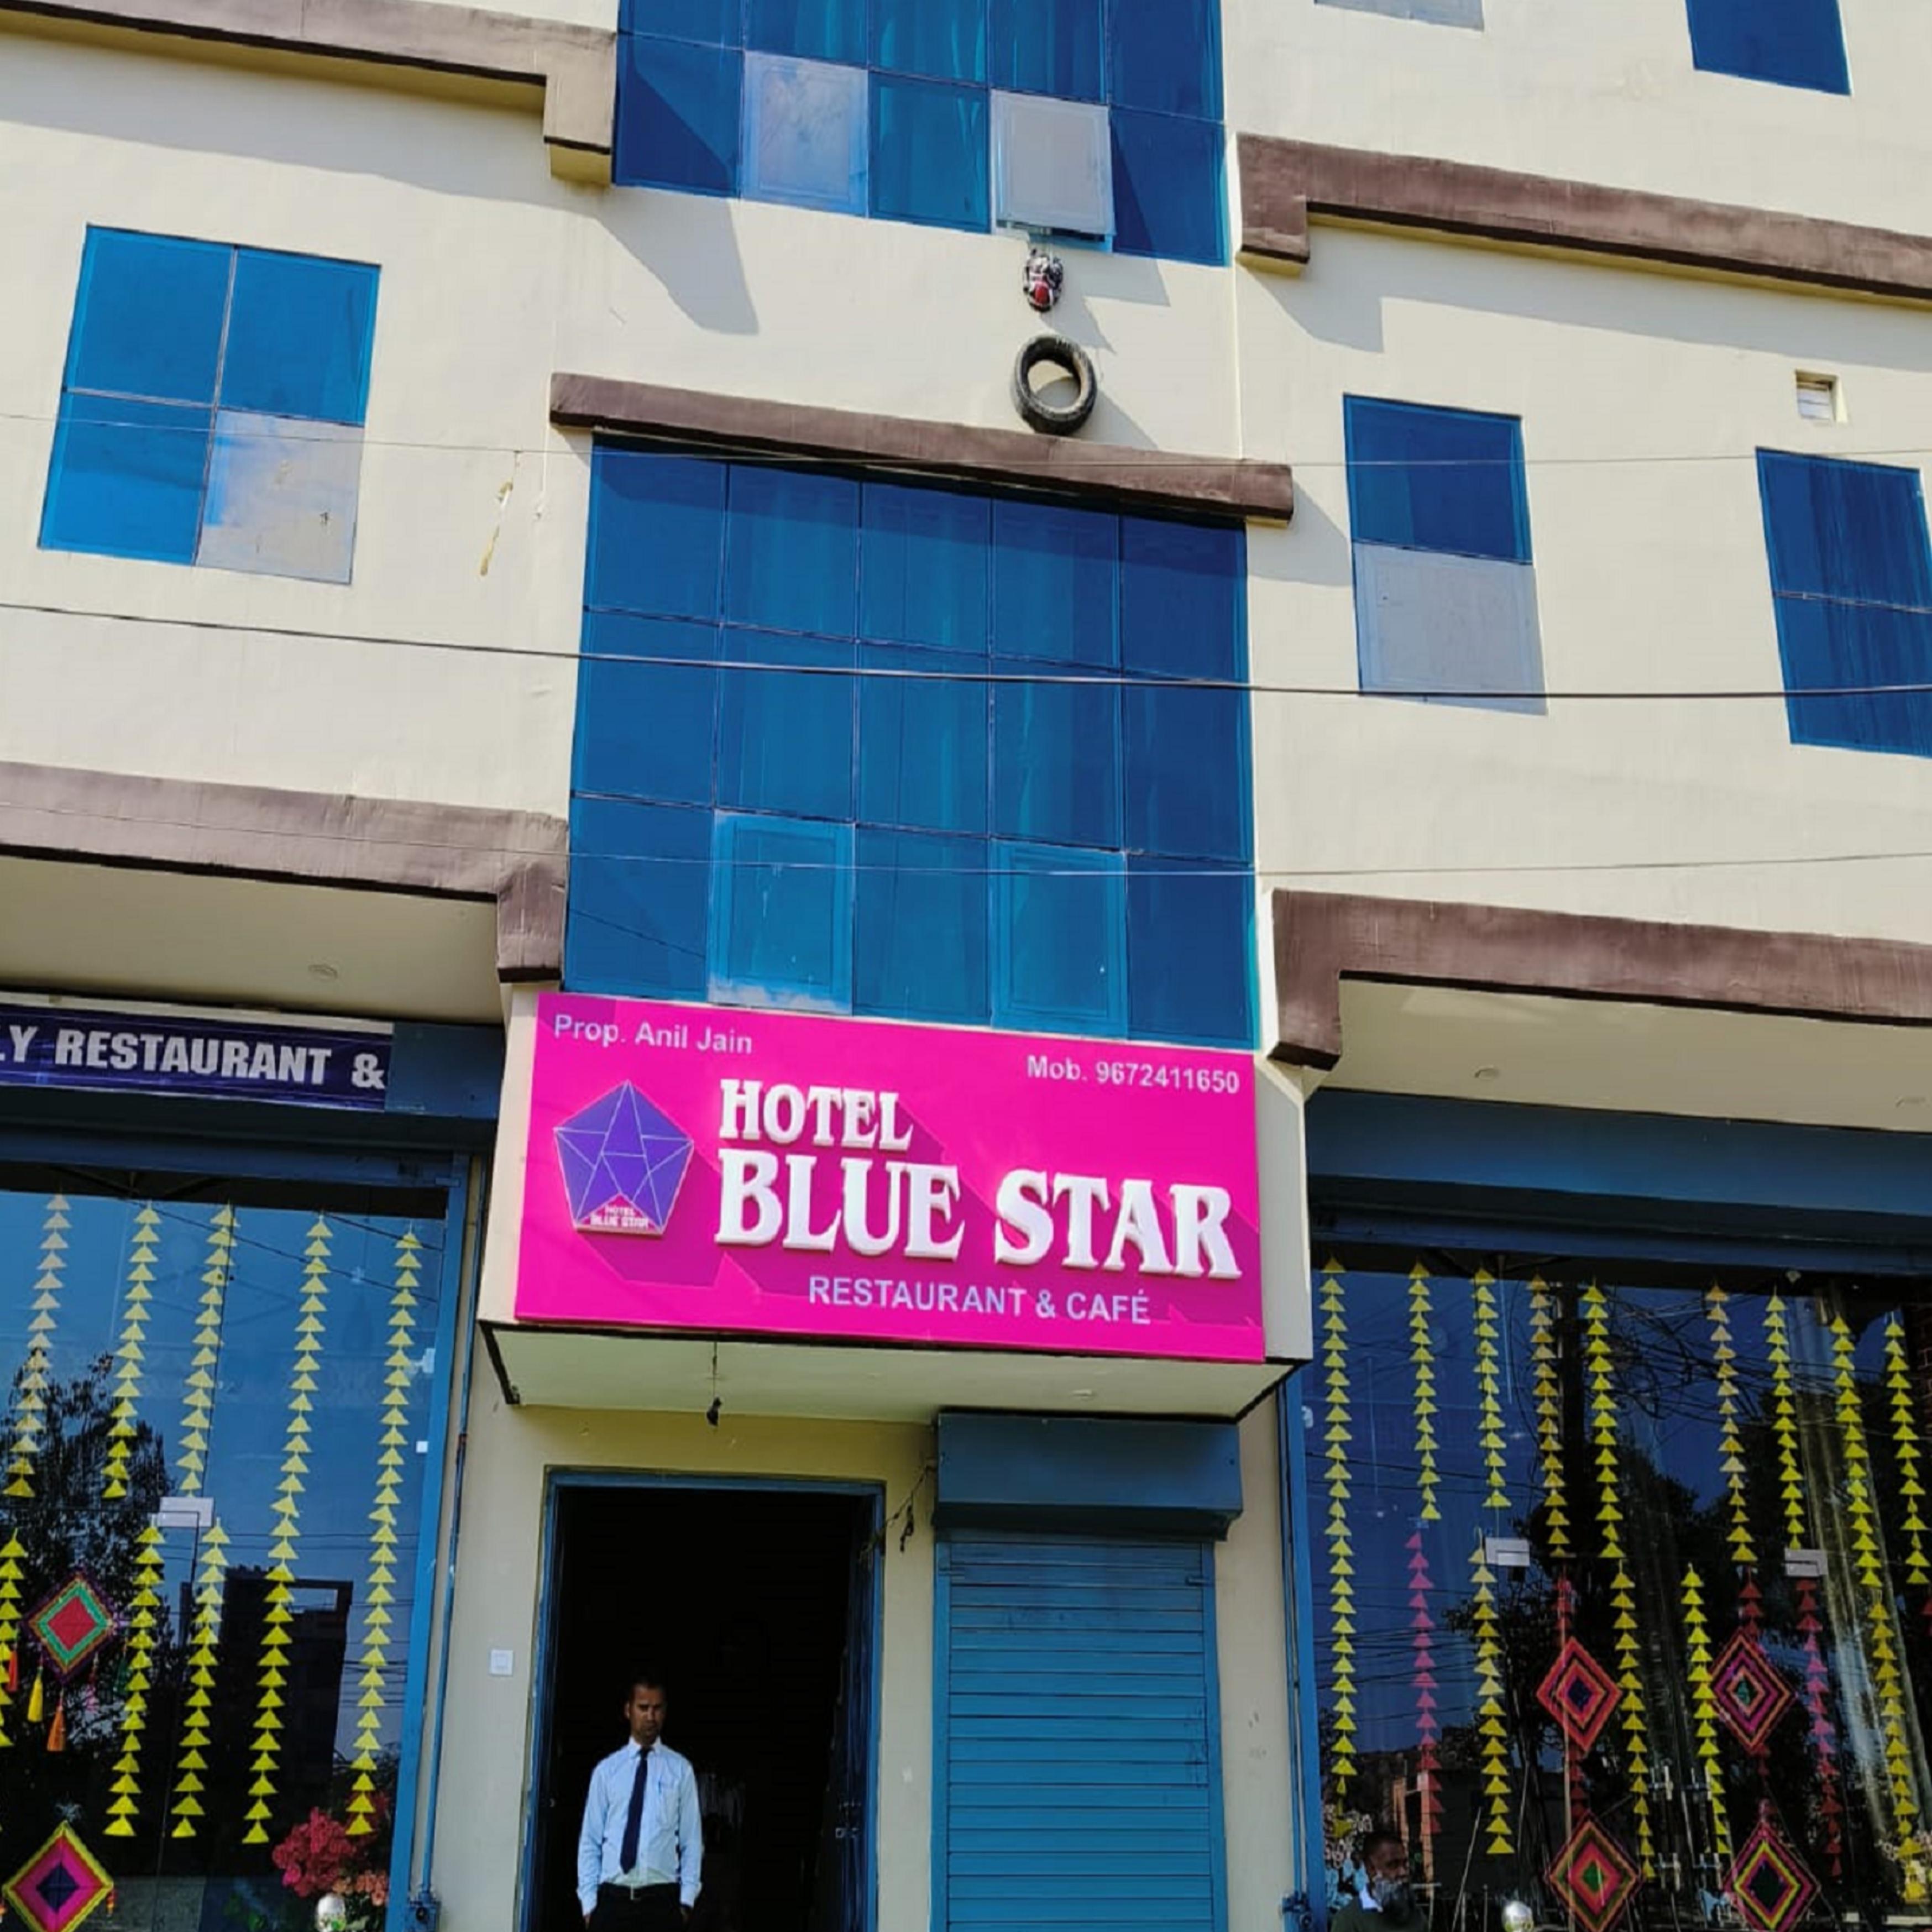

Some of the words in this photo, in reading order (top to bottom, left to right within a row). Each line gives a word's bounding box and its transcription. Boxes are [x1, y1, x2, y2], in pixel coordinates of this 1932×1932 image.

[55, 1028, 332, 1085] RESTAURANT
[351, 1053, 385, 1090] &
[554, 1013, 627, 1048] Prop.
[634, 1022, 688, 1049] Anil
[696, 1027, 753, 1055] Jain
[1027, 1055, 1088, 1081] Mob.
[1095, 1061, 1240, 1095] 9672411650
[719, 1078, 914, 1151] HOTEL
[714, 1147, 966, 1261] BLUE
[994, 1168, 1243, 1279] STAR
[808, 1276, 1027, 1316] RESTAURANT
[1035, 1289, 1056, 1319] &
[1066, 1289, 1151, 1325] CAFÉ
